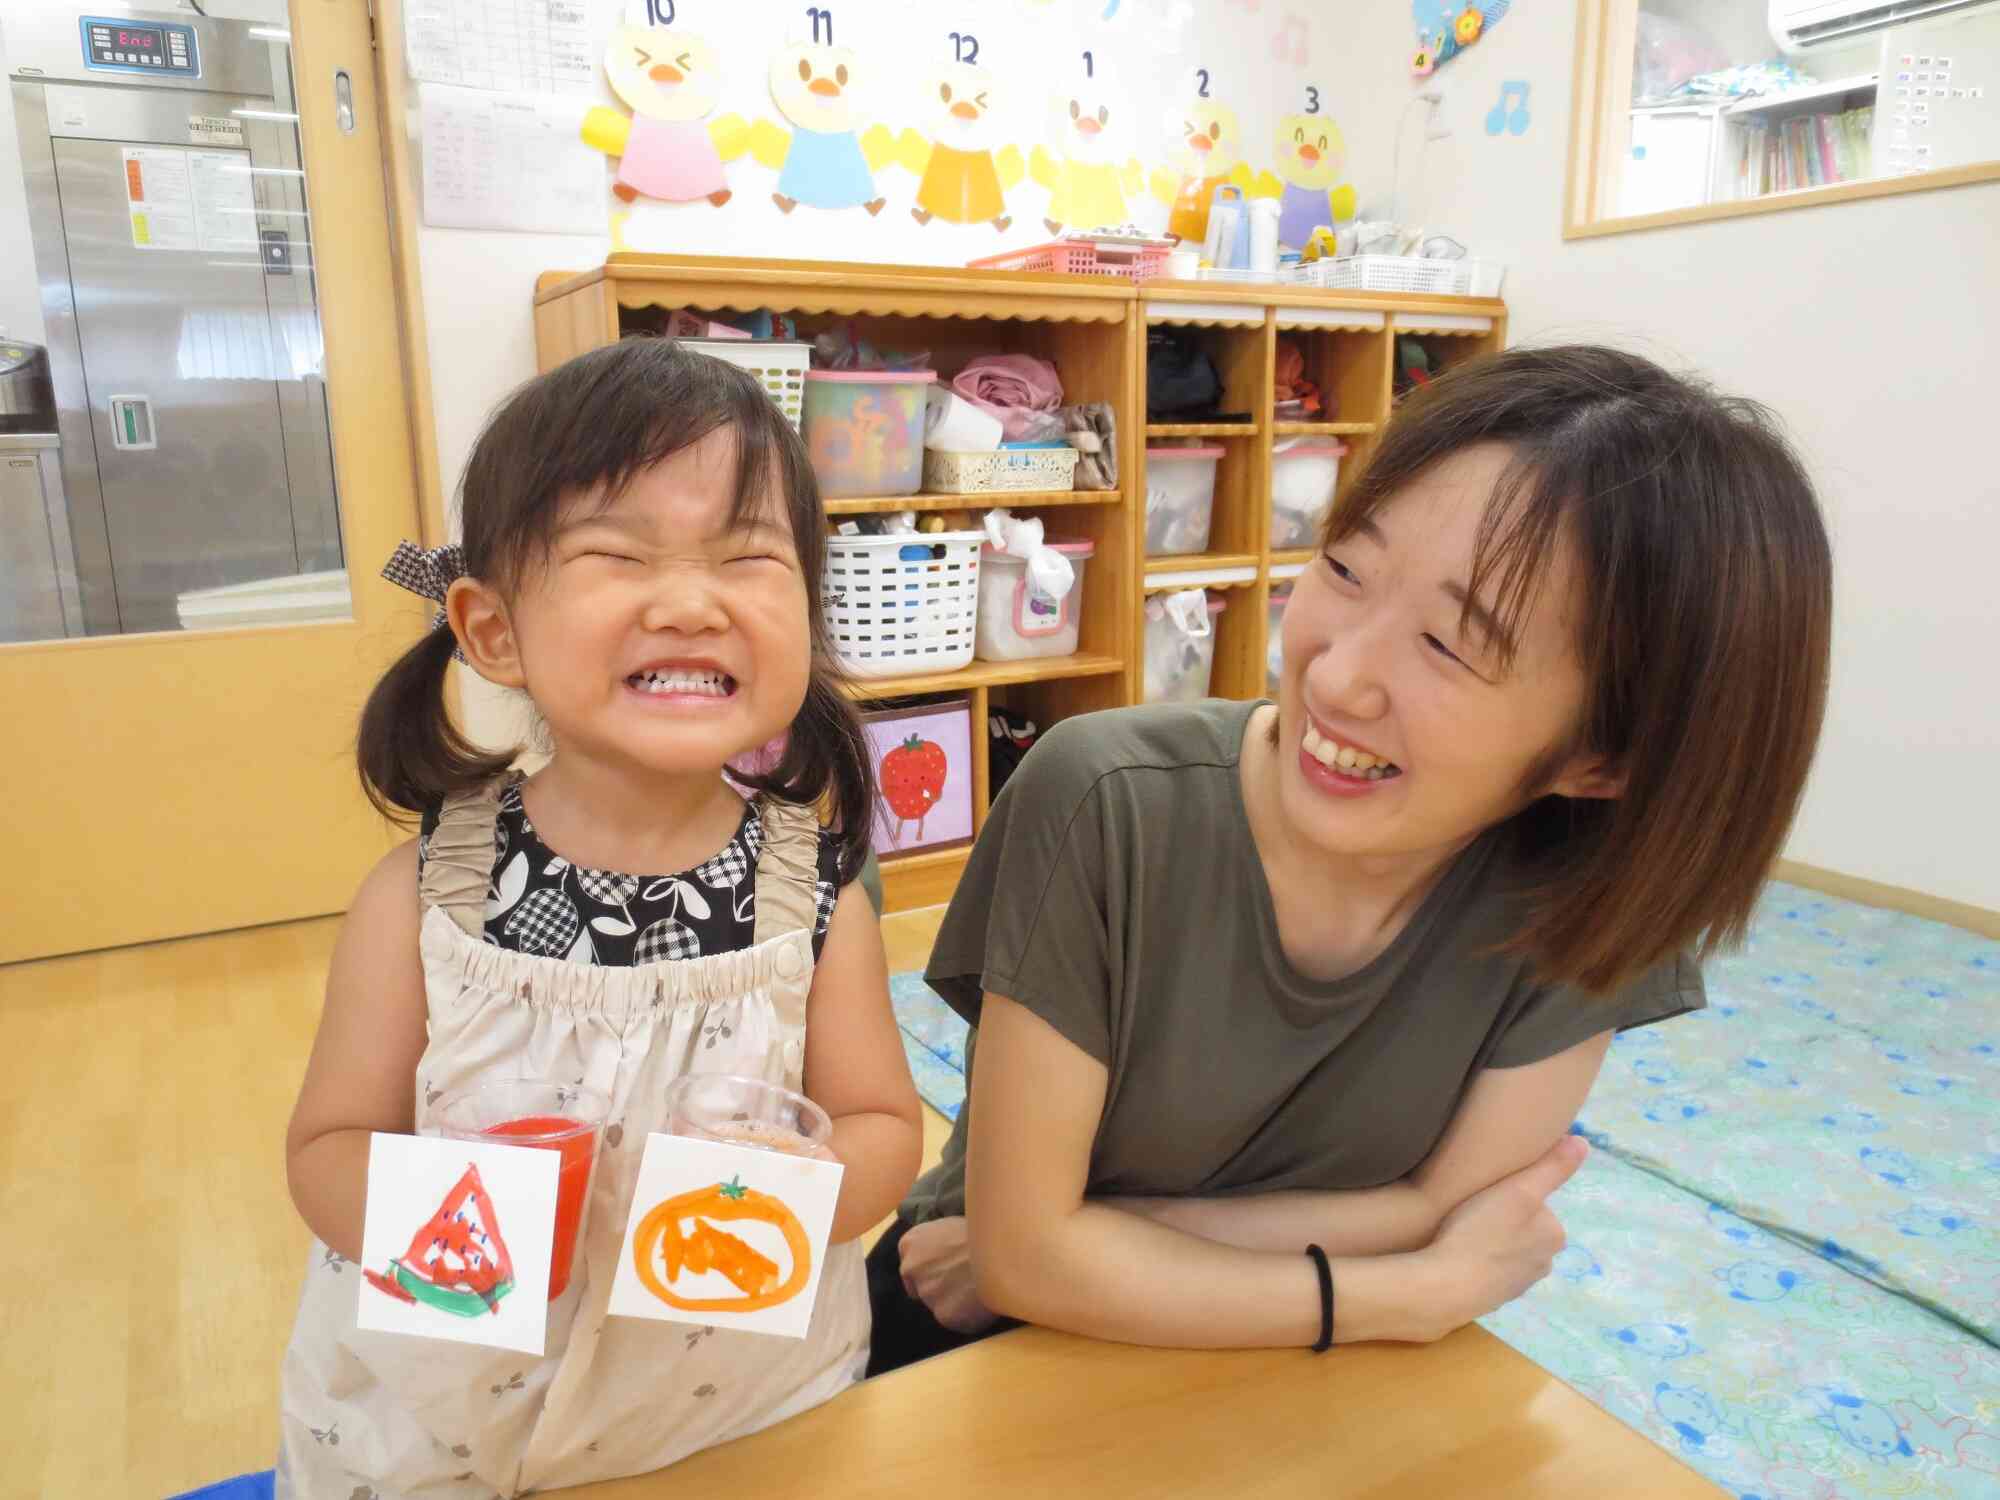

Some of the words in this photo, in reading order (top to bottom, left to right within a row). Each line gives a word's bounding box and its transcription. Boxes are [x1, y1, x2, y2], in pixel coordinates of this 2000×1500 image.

[646, 0, 675, 26] 10
[807, 7, 833, 46] 11
[948, 31, 980, 65] 12
[1081, 51, 1094, 78] 1
[1195, 69, 1210, 98] 2
[1305, 86, 1321, 114] 3
